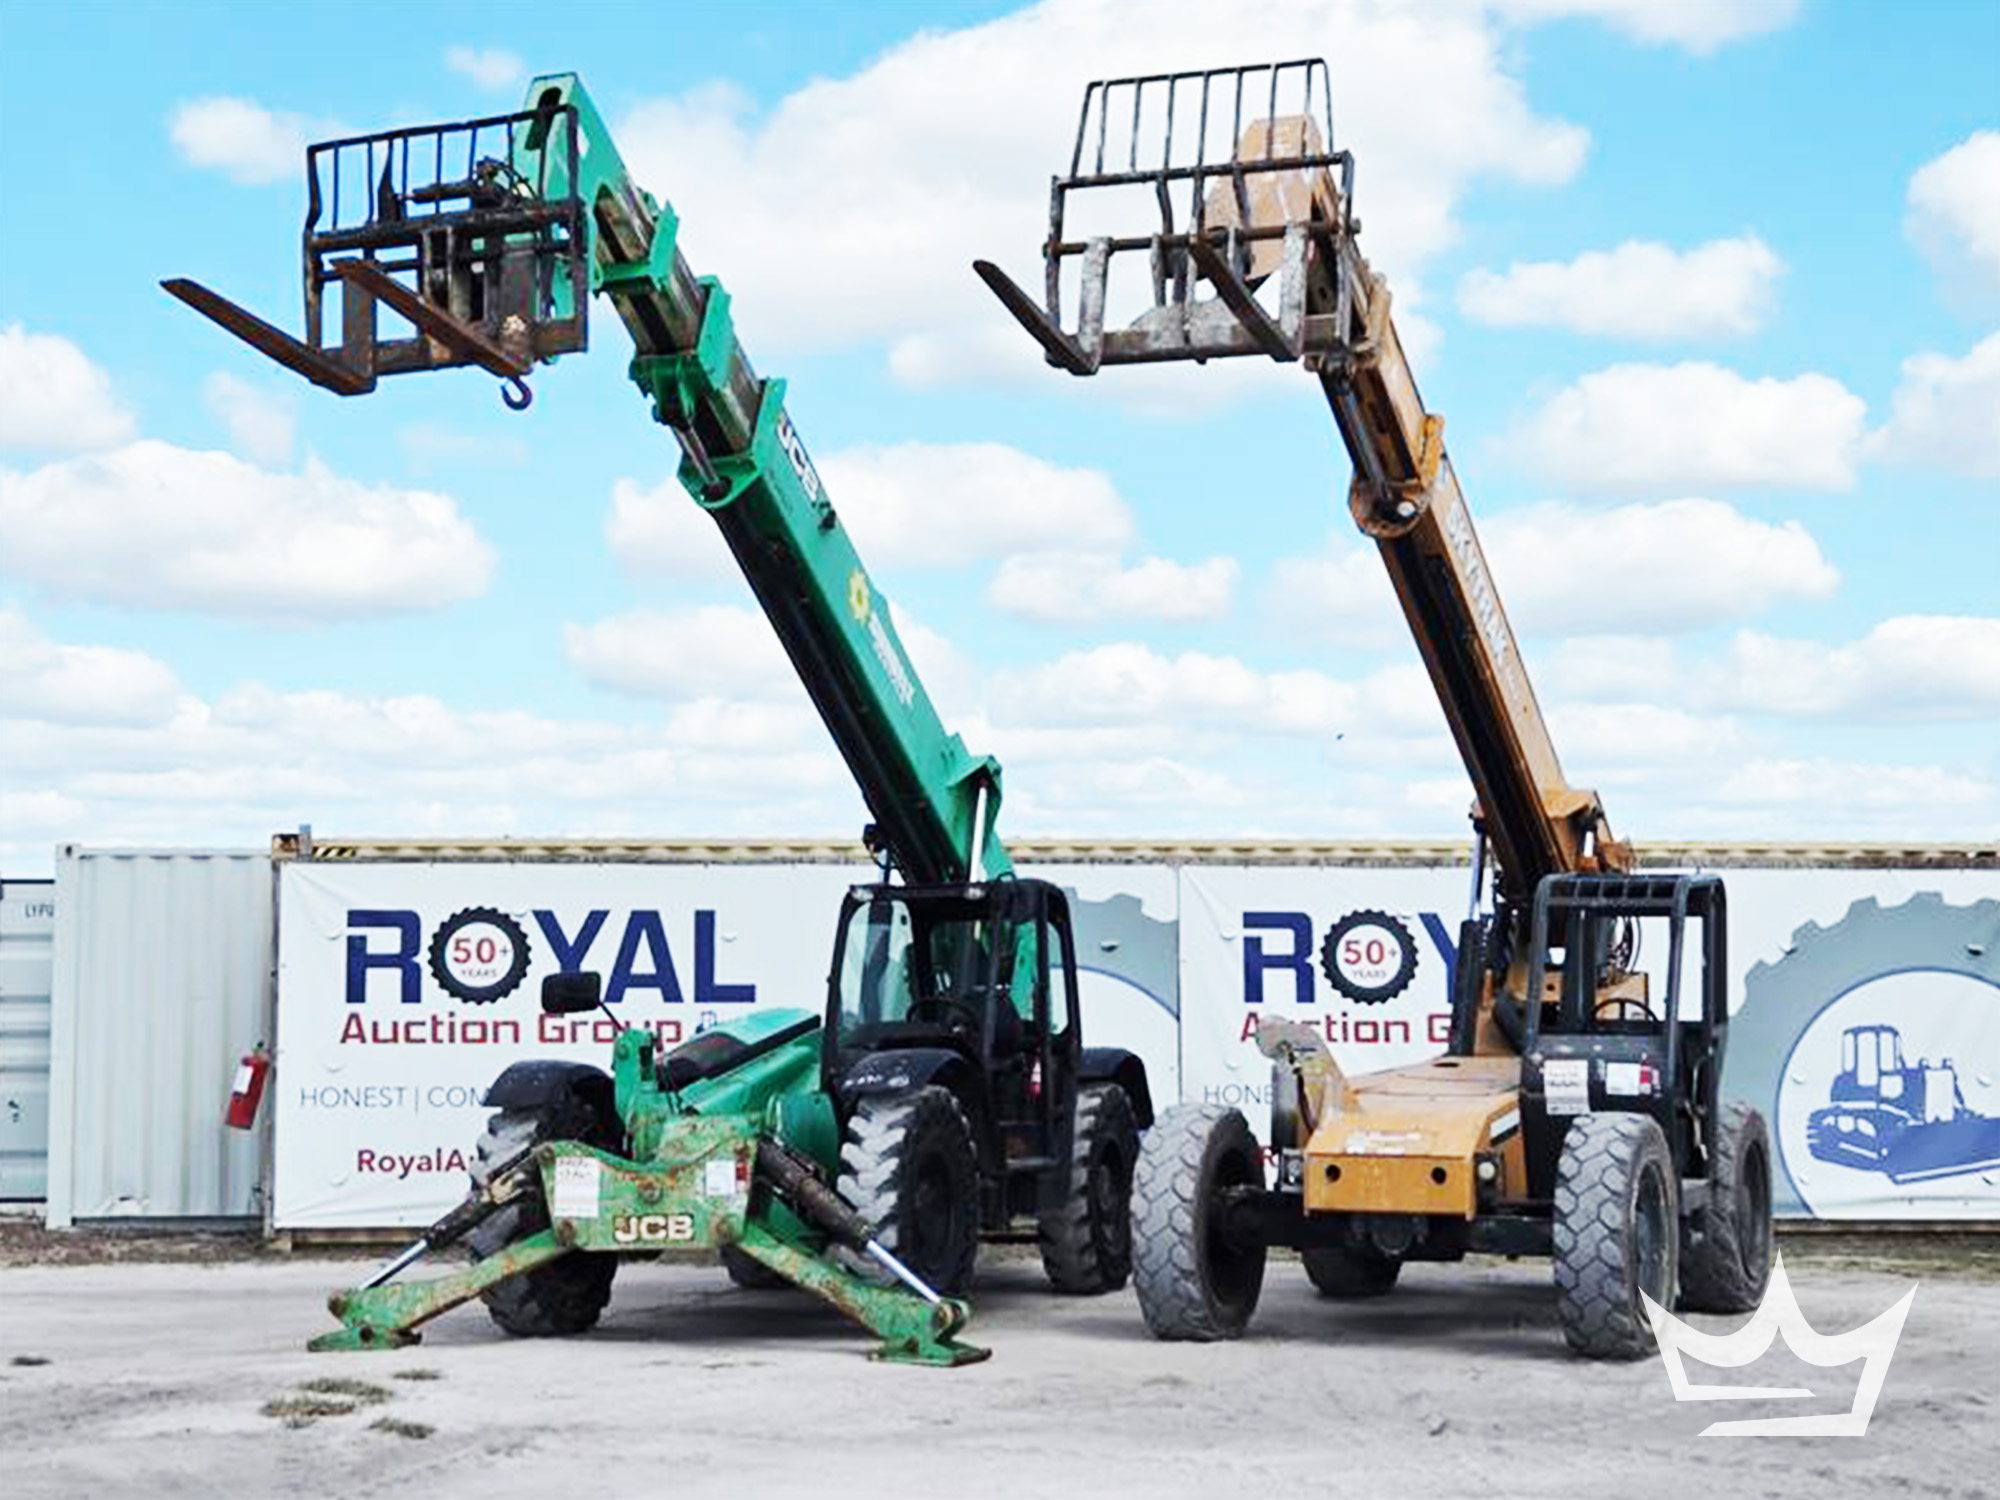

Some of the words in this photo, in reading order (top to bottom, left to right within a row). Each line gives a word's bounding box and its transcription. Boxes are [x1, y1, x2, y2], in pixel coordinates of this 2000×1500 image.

[777, 411, 819, 501] JCB
[346, 905, 756, 1005] ROYAL
[1242, 909, 1460, 1004] ROY
[461, 969, 498, 978] YEARS
[1351, 969, 1388, 979] YEARS
[340, 1012, 520, 1044] Auction
[1240, 1011, 1410, 1043] Ation
[300, 1086, 407, 1108] HONEST
[427, 1086, 493, 1108] COM
[357, 1147, 475, 1180] RoyalA
[613, 1212, 695, 1243] JCB
